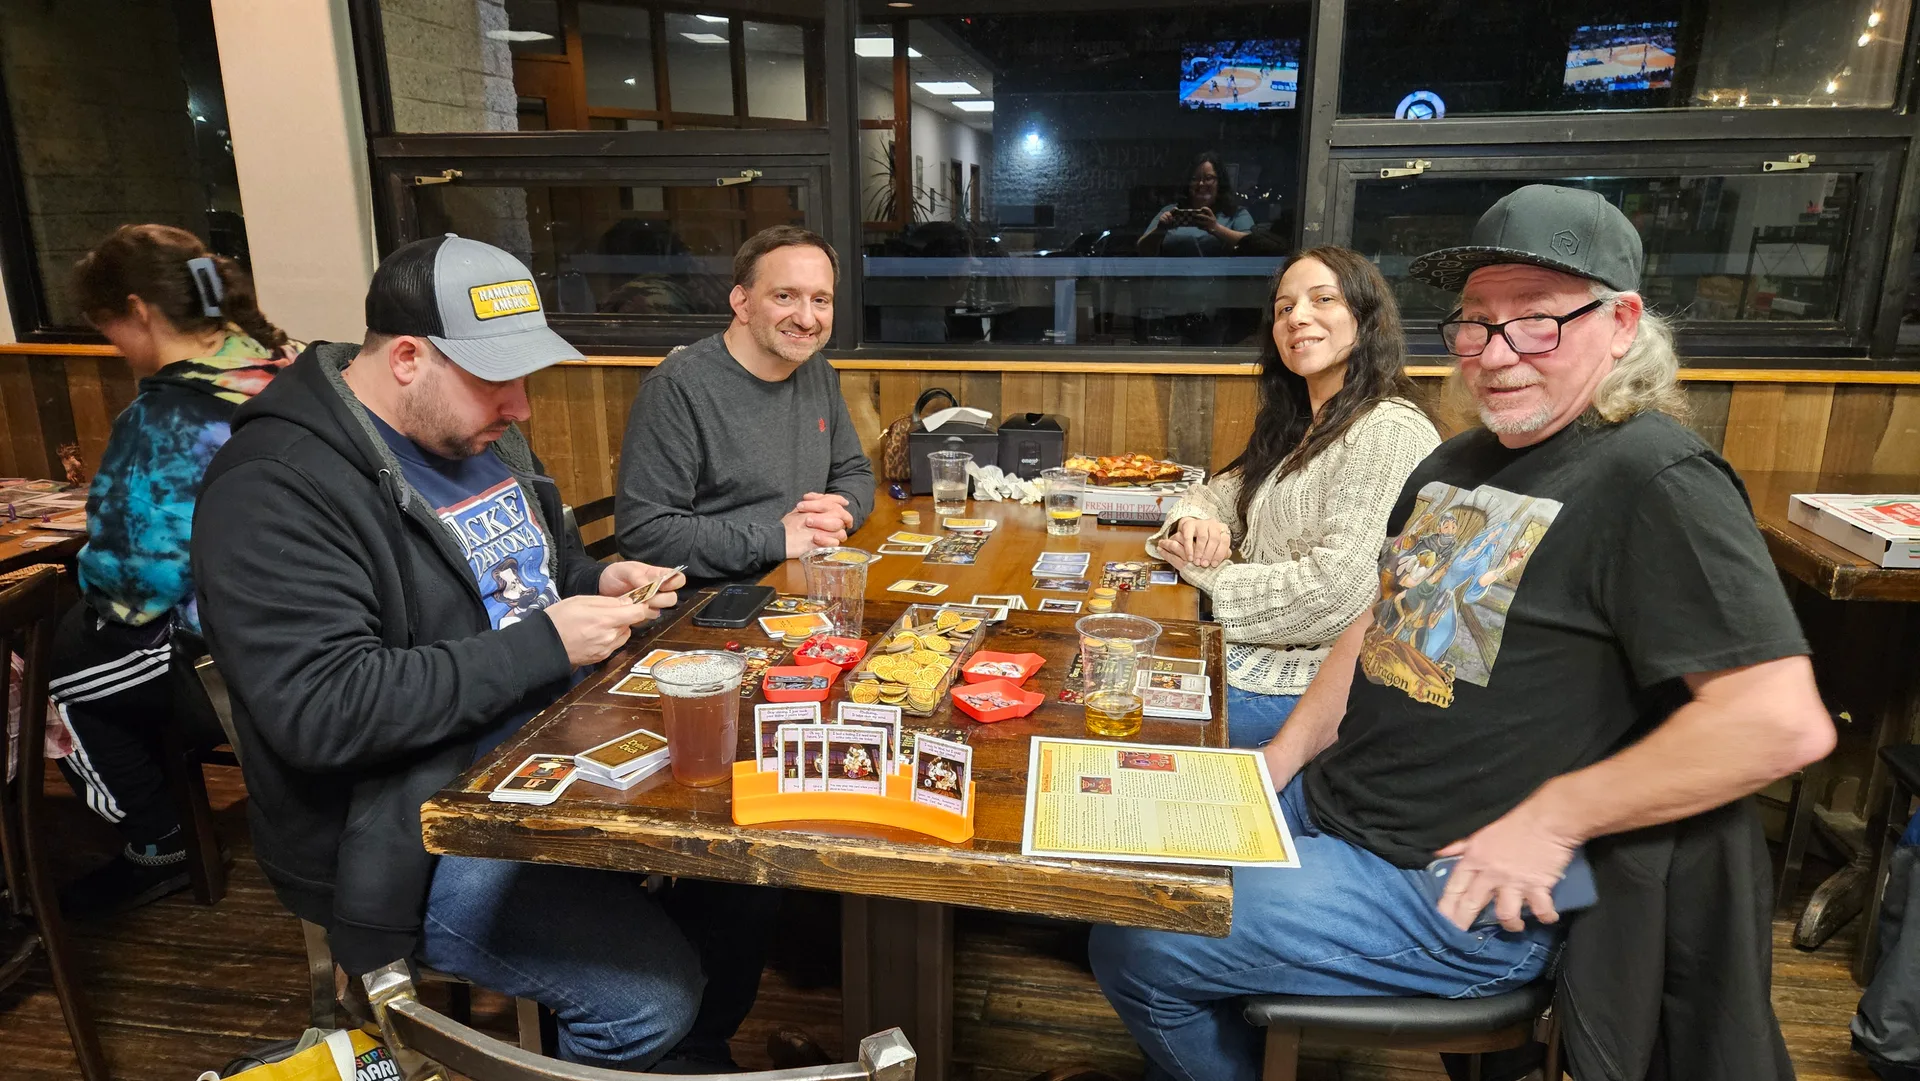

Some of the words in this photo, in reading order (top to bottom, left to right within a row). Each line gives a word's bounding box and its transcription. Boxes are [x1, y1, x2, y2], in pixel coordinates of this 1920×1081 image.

[1085, 501, 1113, 511] FRESH
[1115, 503, 1135, 512] HOT
[1137, 504, 1162, 514] PIZZA
[471, 525, 541, 581] DAYTONA
[1413, 679, 1447, 705] Inn
[355, 1048, 392, 1068] SUPER
[356, 1059, 398, 1081] MARI
